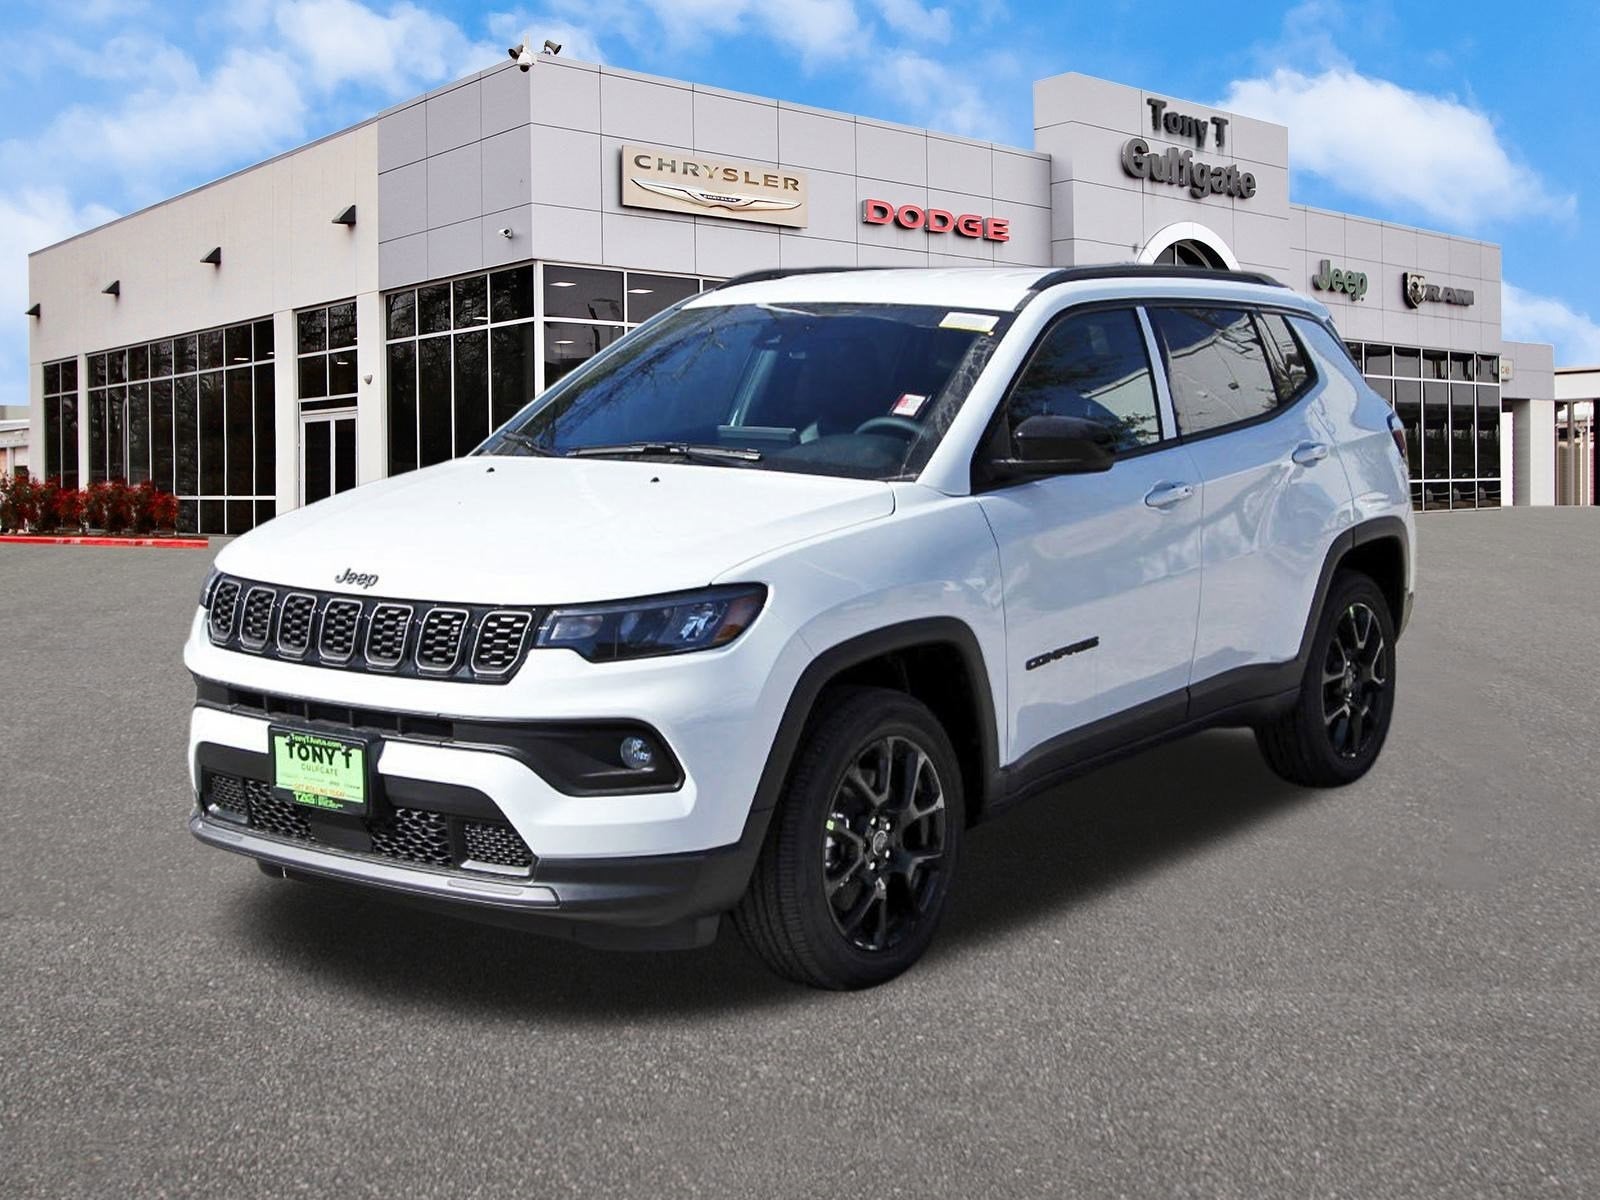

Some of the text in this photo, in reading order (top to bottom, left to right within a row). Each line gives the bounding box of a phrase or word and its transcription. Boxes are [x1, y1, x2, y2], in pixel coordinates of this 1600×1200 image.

[1147, 98, 1229, 147] Tony T
[634, 154, 800, 191] CHRYSLER
[1121, 138, 1257, 199] Gulfgate
[862, 198, 1010, 242] DODGE
[1312, 259, 1368, 301] Jeep
[1424, 284, 1475, 307] RAM
[335, 568, 379, 590] Jeep
[285, 740, 337, 766] TONY
